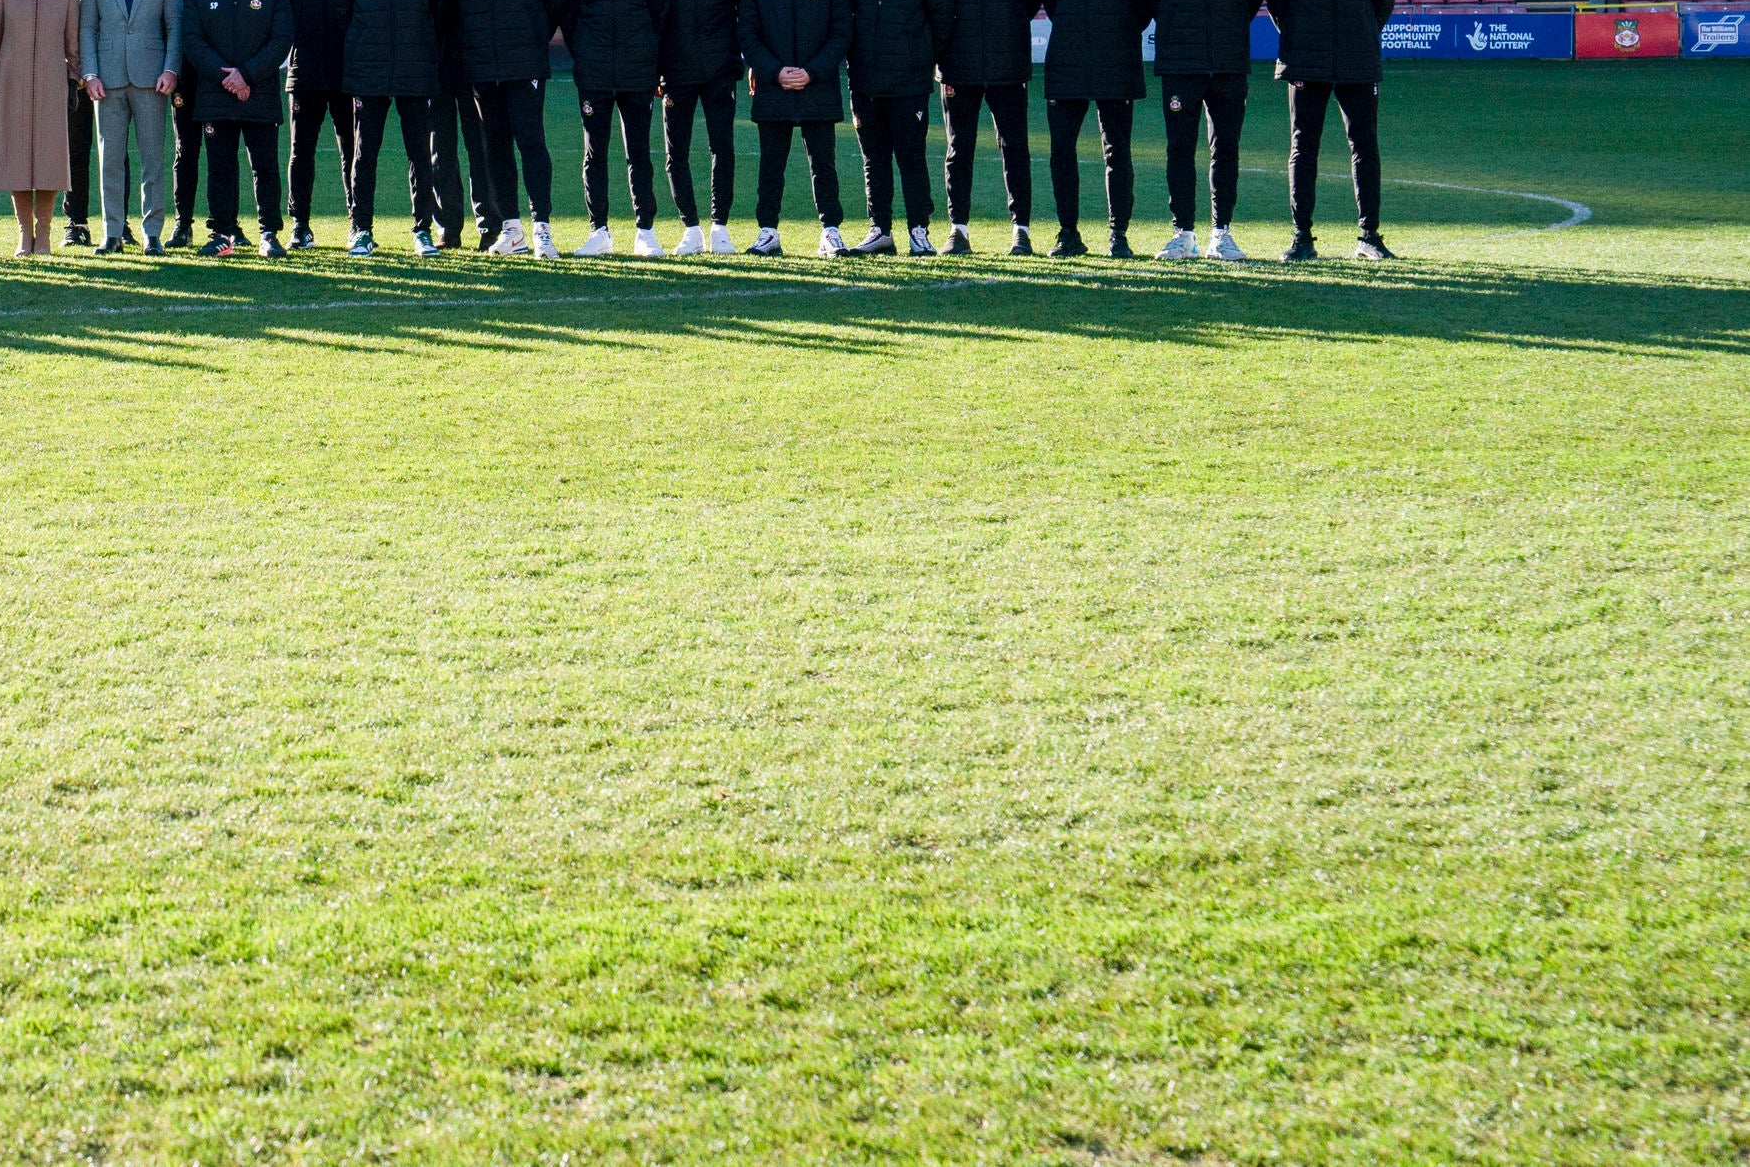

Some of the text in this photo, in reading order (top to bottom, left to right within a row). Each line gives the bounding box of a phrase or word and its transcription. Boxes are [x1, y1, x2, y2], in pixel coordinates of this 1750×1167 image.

[210, 1, 219, 10] SP
[1381, 24, 1442, 33] SUPPORTING
[1489, 24, 1507, 32] THE
[1381, 33, 1441, 41] COMMUNITY
[1490, 33, 1535, 41] NATIONAL
[1381, 41, 1432, 49] FOOTBALL
[1490, 41, 1530, 50] LOTTERY
